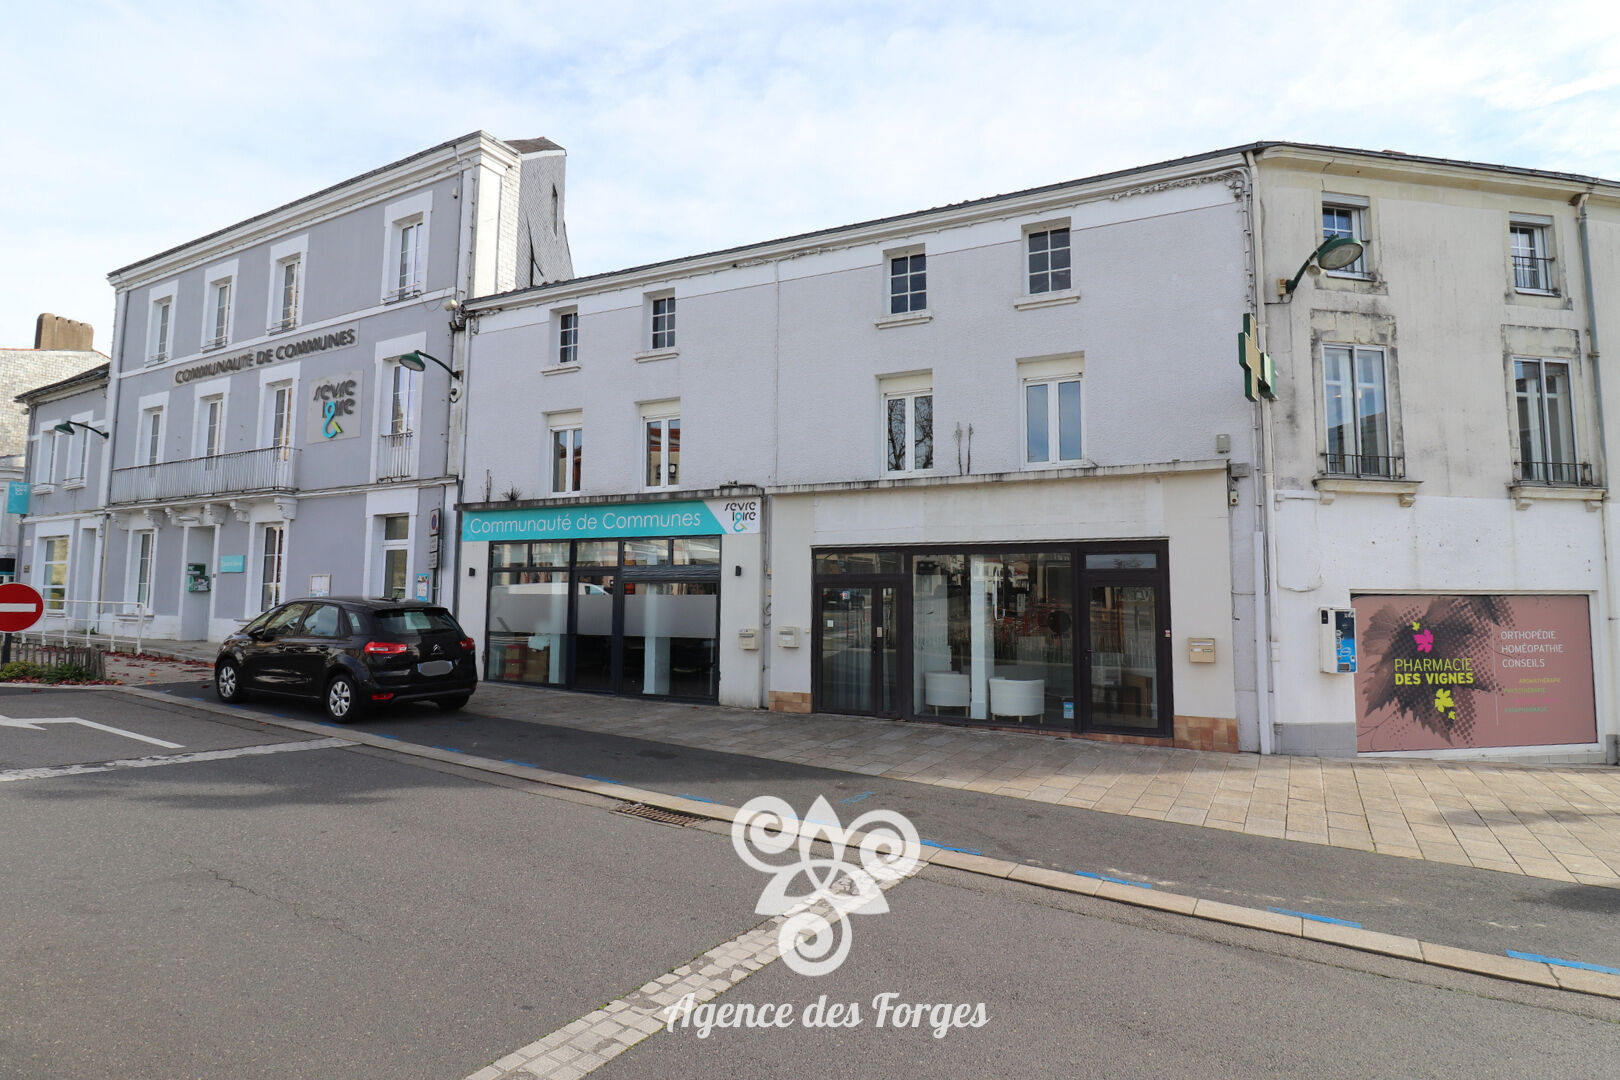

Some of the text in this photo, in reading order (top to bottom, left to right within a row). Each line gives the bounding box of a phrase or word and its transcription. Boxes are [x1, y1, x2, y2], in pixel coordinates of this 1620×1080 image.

[256, 348, 274, 365] DE
[276, 328, 356, 361] COMMUNES
[469, 507, 701, 535] Communauté de Communes
[1501, 628, 1557, 640] ORTHOPÉDIE
[1501, 642, 1564, 654] HOMÉOPATHIE
[1394, 657, 1474, 672] PHARMACIE
[1502, 658, 1546, 667] CONSEILS
[1394, 672, 1475, 686] DES VIGNES
